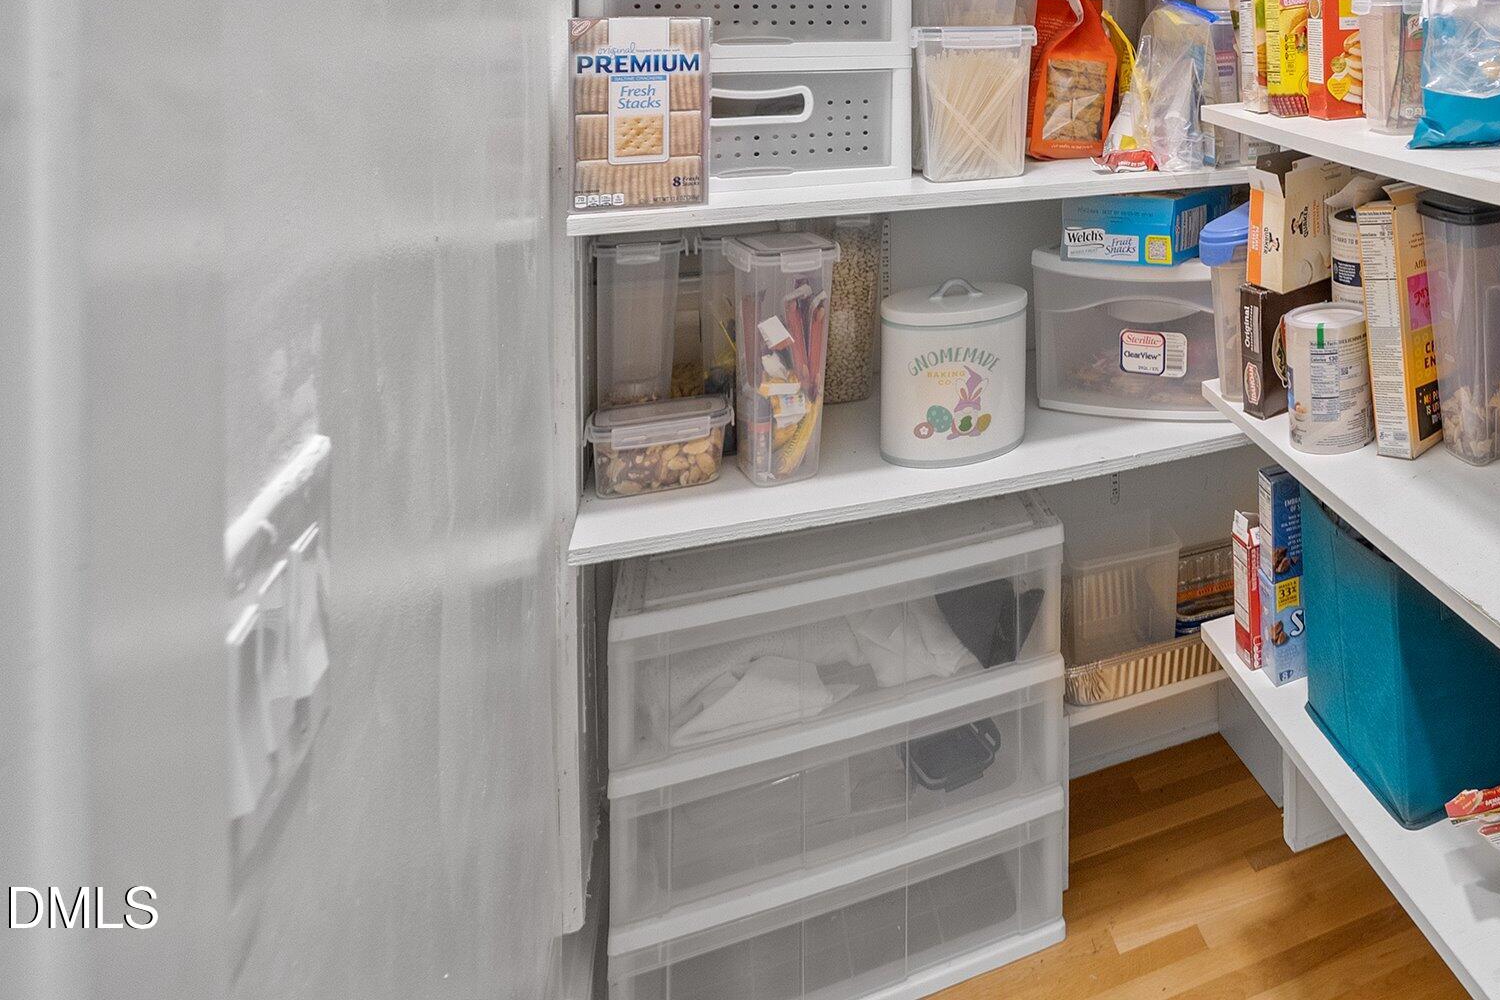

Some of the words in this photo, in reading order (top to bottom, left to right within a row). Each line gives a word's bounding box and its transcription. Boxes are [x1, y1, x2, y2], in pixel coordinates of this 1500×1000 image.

[598, 42, 636, 55] original
[576, 53, 700, 74] PREMIUM
[620, 85, 656, 97] Fresh
[617, 97, 662, 109] Stacks
[672, 176, 681, 187] 8
[1067, 231, 1104, 243] Welch's
[1112, 237, 1133, 247] Fruit
[1105, 244, 1136, 255] Snacks
[1126, 333, 1159, 345] Sterilite
[1124, 350, 1158, 360] ClearView
[907, 347, 1001, 376] GNOMEMADE
[1248, 365, 1257, 404] IDAHOAN
